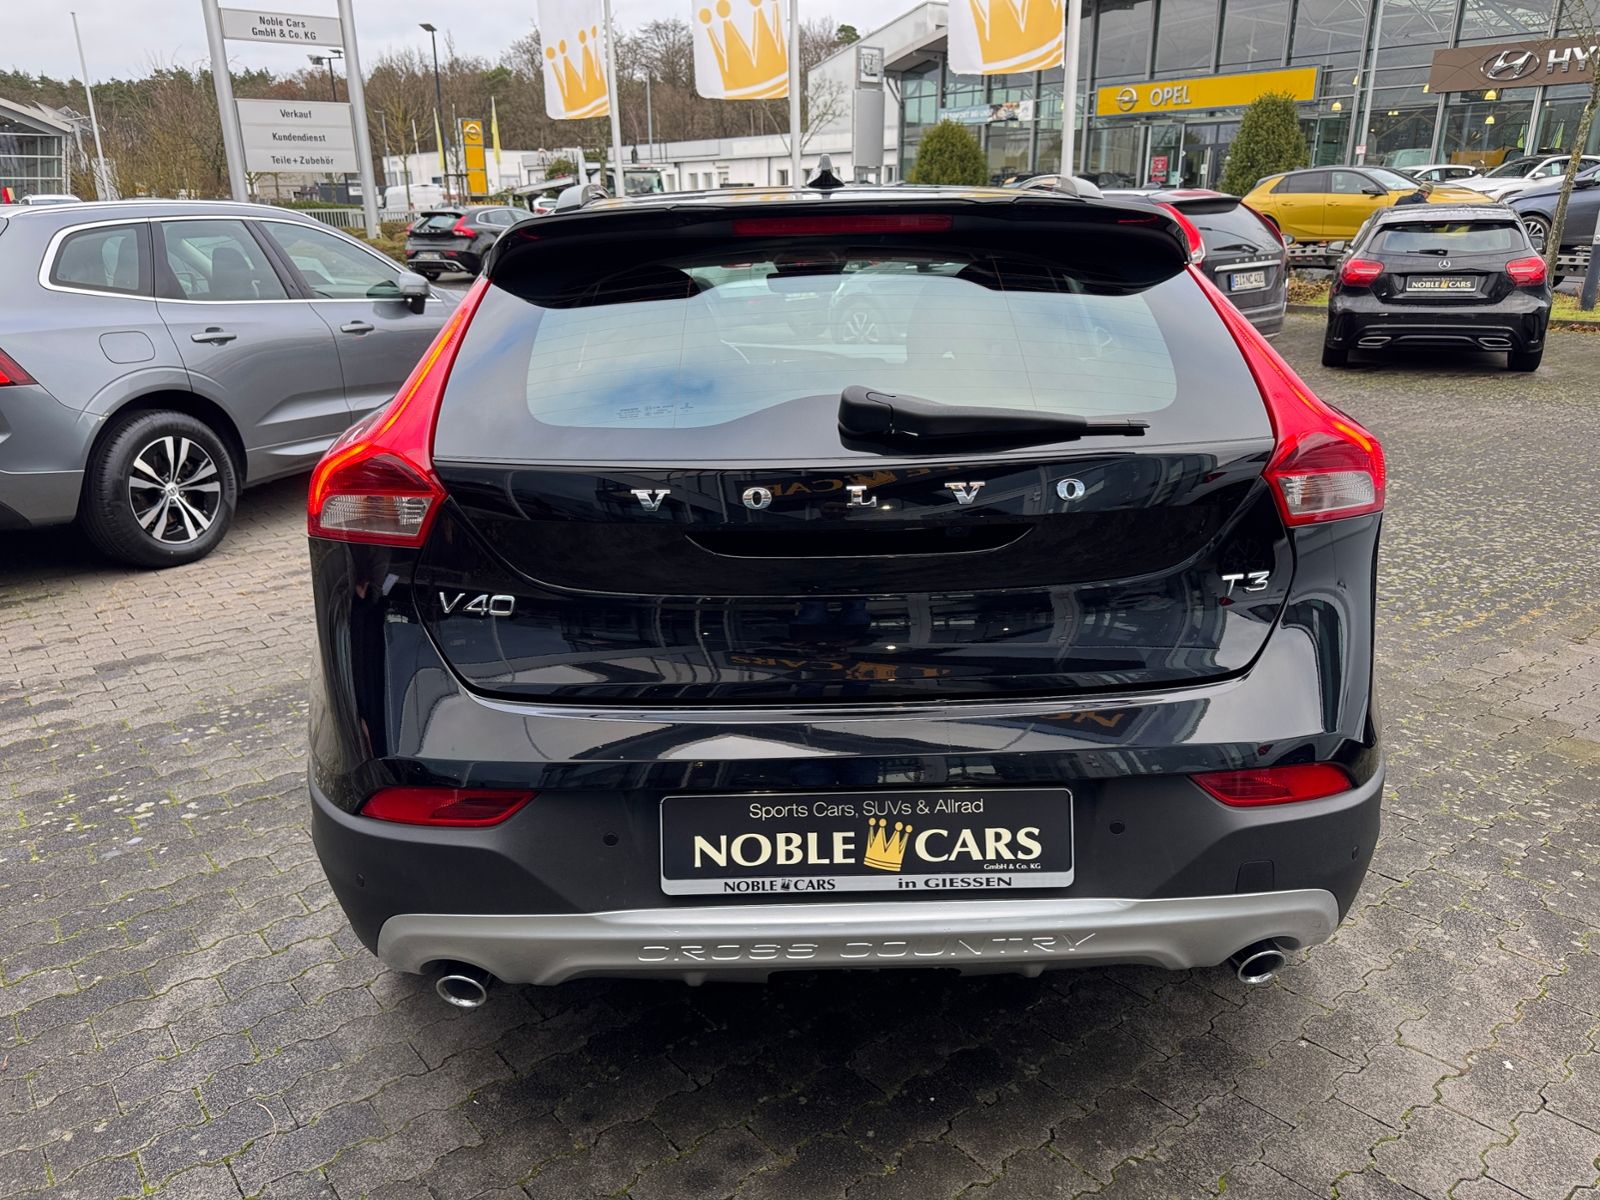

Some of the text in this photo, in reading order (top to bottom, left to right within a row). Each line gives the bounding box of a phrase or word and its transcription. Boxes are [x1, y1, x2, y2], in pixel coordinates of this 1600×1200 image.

[252, 27, 317, 40] GmbH & Co. KG
[259, 16, 306, 28] Noble Cars
[1547, 45, 1600, 74] HY
[1150, 86, 1192, 106] OPEL
[280, 109, 312, 119] Verkauf
[272, 132, 327, 142] Kundendienst
[631, 477, 1086, 512] VOLVO
[1222, 571, 1270, 596] T3
[439, 592, 515, 616] V40
[750, 798, 984, 821] Sports Cars, SUVs & Allrad
[693, 826, 1042, 868] NOBLE CARS
[724, 876, 1012, 892] NOBLE CARS in GIESSEN
[638, 932, 1096, 962] CROSS COUNTRY
